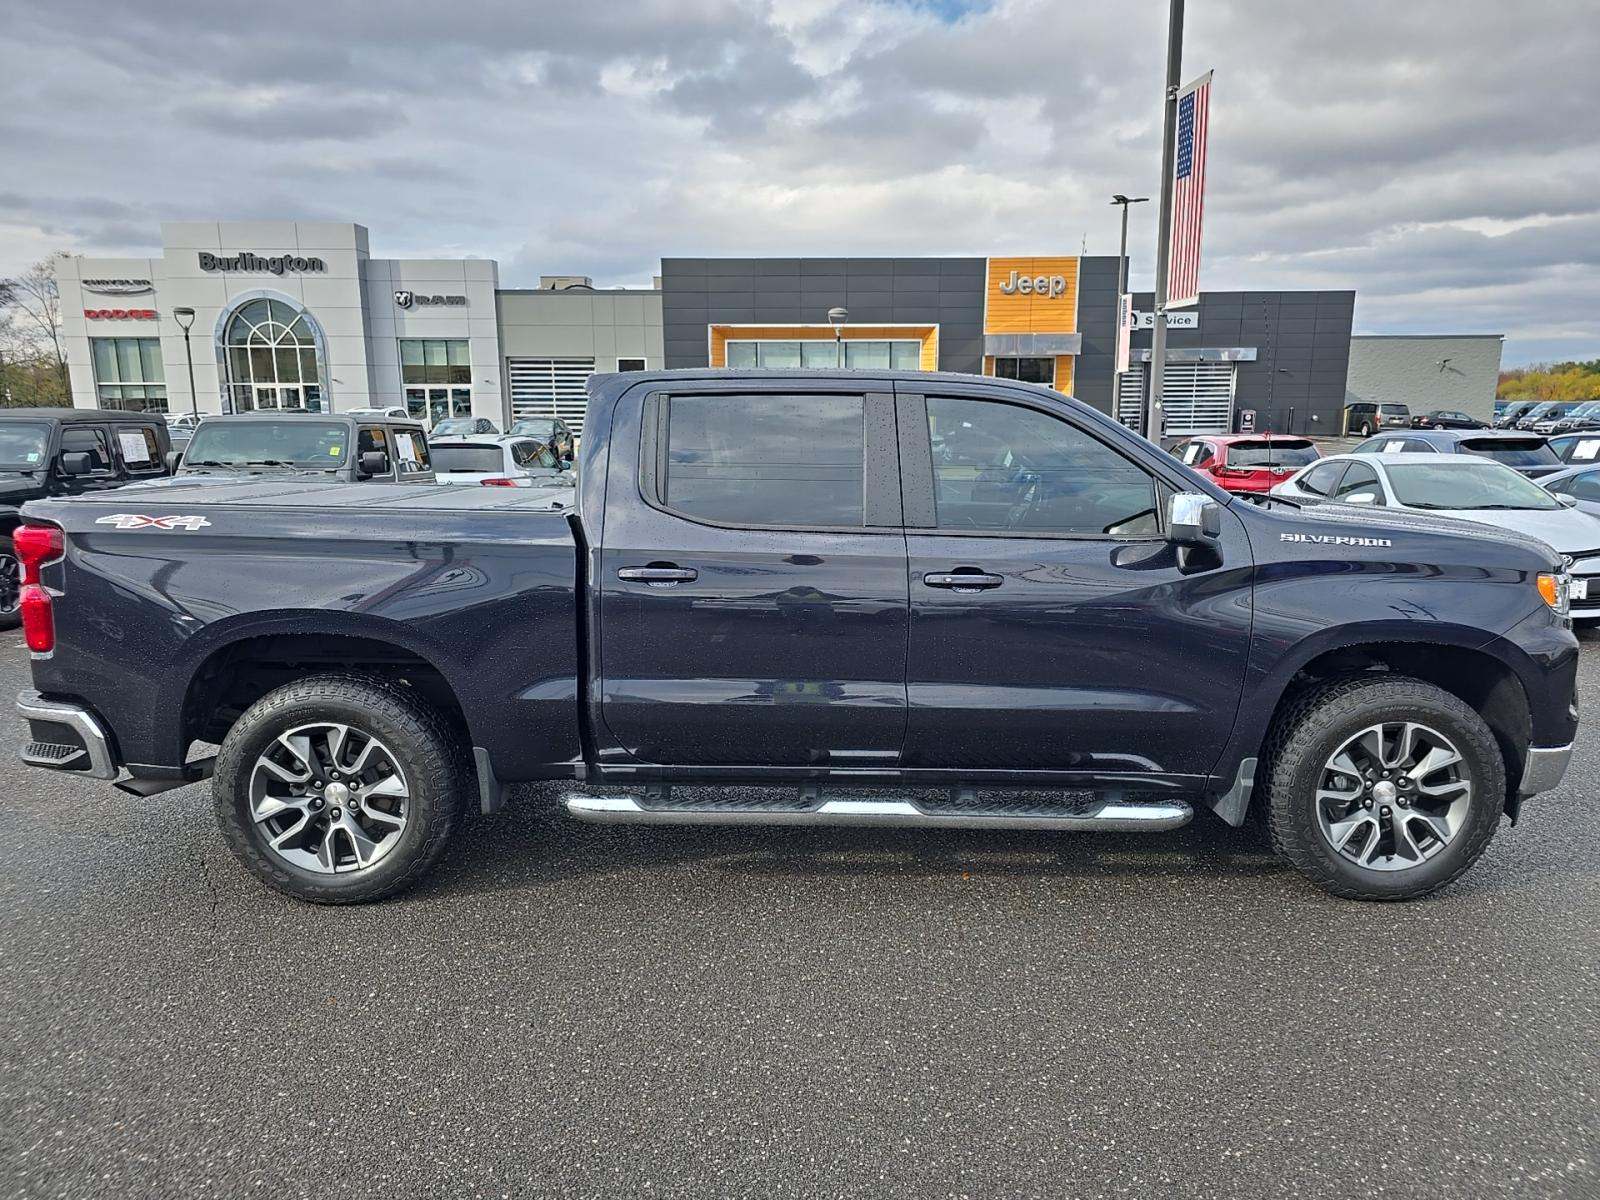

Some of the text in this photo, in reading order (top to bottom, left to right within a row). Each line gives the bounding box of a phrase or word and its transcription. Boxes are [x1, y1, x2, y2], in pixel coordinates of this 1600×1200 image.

[198, 252, 323, 276] Burlington
[999, 270, 1066, 298] Jeep
[415, 295, 466, 305] RAM
[84, 309, 158, 319] DODGE
[1145, 316, 1191, 325] Svice
[1279, 532, 1392, 547] SILVERADO
